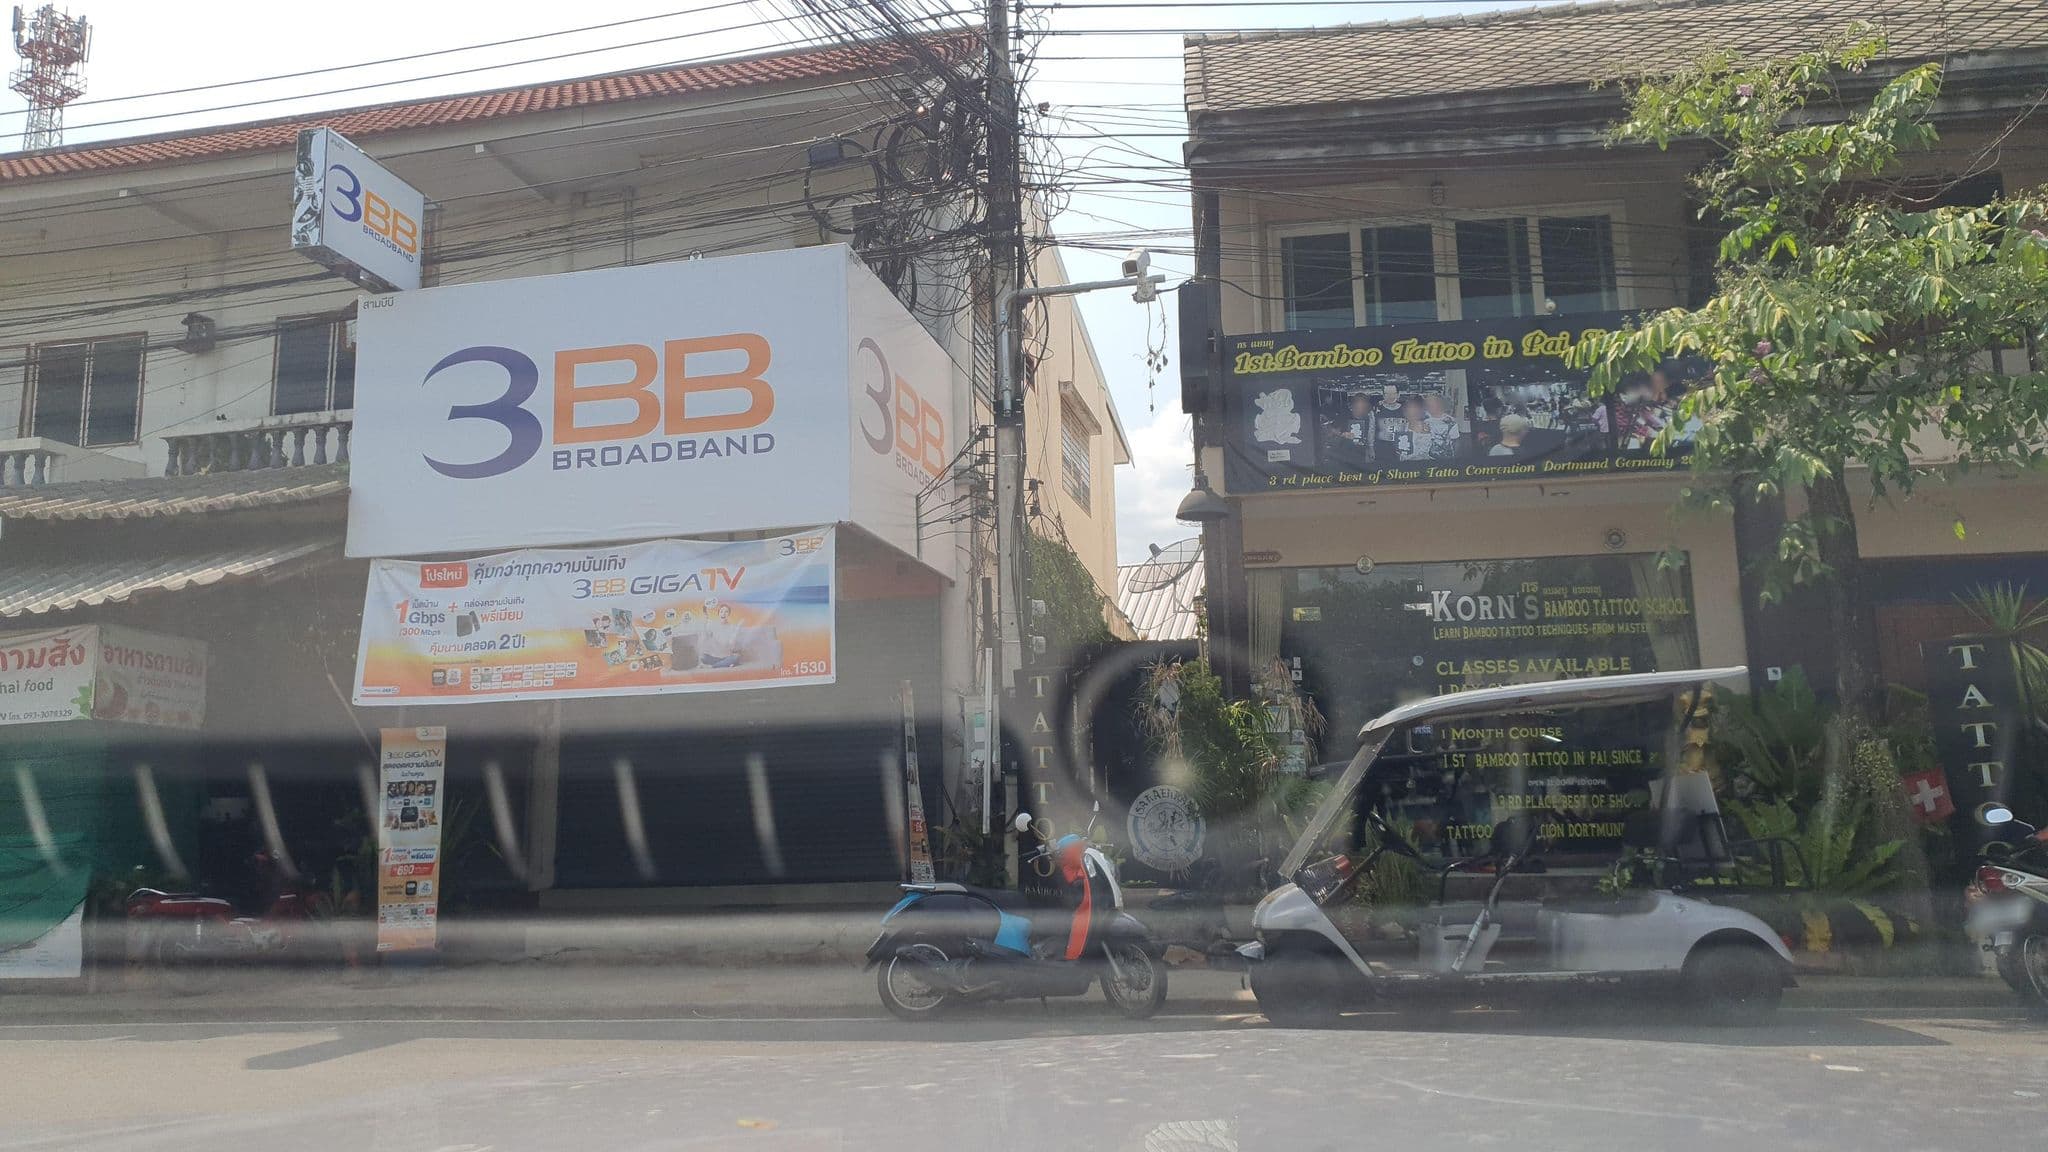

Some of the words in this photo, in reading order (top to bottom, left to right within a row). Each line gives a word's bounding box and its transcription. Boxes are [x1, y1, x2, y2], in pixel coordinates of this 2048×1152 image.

[328, 163, 417, 254] 3BB
[362, 224, 415, 263] BROADBAND
[1391, 337, 1476, 365] Tattoo
[1483, 335, 1514, 359] in
[422, 332, 775, 480] 3BB
[857, 337, 946, 481] 3BB
[552, 432, 776, 471] BROADBAND
[1269, 476, 1278, 486] 3
[1283, 474, 1297, 485] rd
[1302, 473, 1333, 487] place
[1338, 471, 1363, 483] best
[1368, 469, 1383, 484] of
[1386, 467, 1421, 480] Show
[1427, 465, 1460, 478] Tatto
[1465, 462, 1536, 476] Convention
[1543, 459, 1609, 473] Dortmund
[1614, 457, 1675, 470] Germany
[425, 567, 464, 583] โปรใหม่
[474, 555, 627, 584] คุ้มกว่าทุกความบันเทิง
[571, 577, 627, 599] 3BB
[630, 566, 747, 595] GIGATV
[395, 600, 410, 624] 1
[480, 607, 525, 623] พรีเมียม
[1544, 599, 1590, 617] BAMBOO
[1593, 597, 1640, 615] TATTOO
[1647, 596, 1689, 615] SCHOOL
[408, 610, 446, 626] Gbps
[1499, 625, 1534, 637] TATTOO
[1536, 623, 1589, 636] TECHNIQUES
[1592, 622, 1615, 634] FROM
[499, 633, 512, 650] 2
[793, 661, 826, 674] 1530
[1436, 659, 1520, 676] CLASSES
[1526, 656, 1632, 673] AVAILABLE
[24, 677, 54, 693] food
[1475, 752, 1519, 768] BAMBOO
[1522, 751, 1569, 766] TATTOO
[1573, 751, 1585, 766] IN
[1590, 750, 1607, 765] PAI
[1612, 749, 1643, 764] SINCE
[1525, 794, 1558, 809] PLACE
[1562, 794, 1587, 809] BEST
[1591, 794, 1607, 808] OF
[1446, 824, 1493, 840] TATTOO
